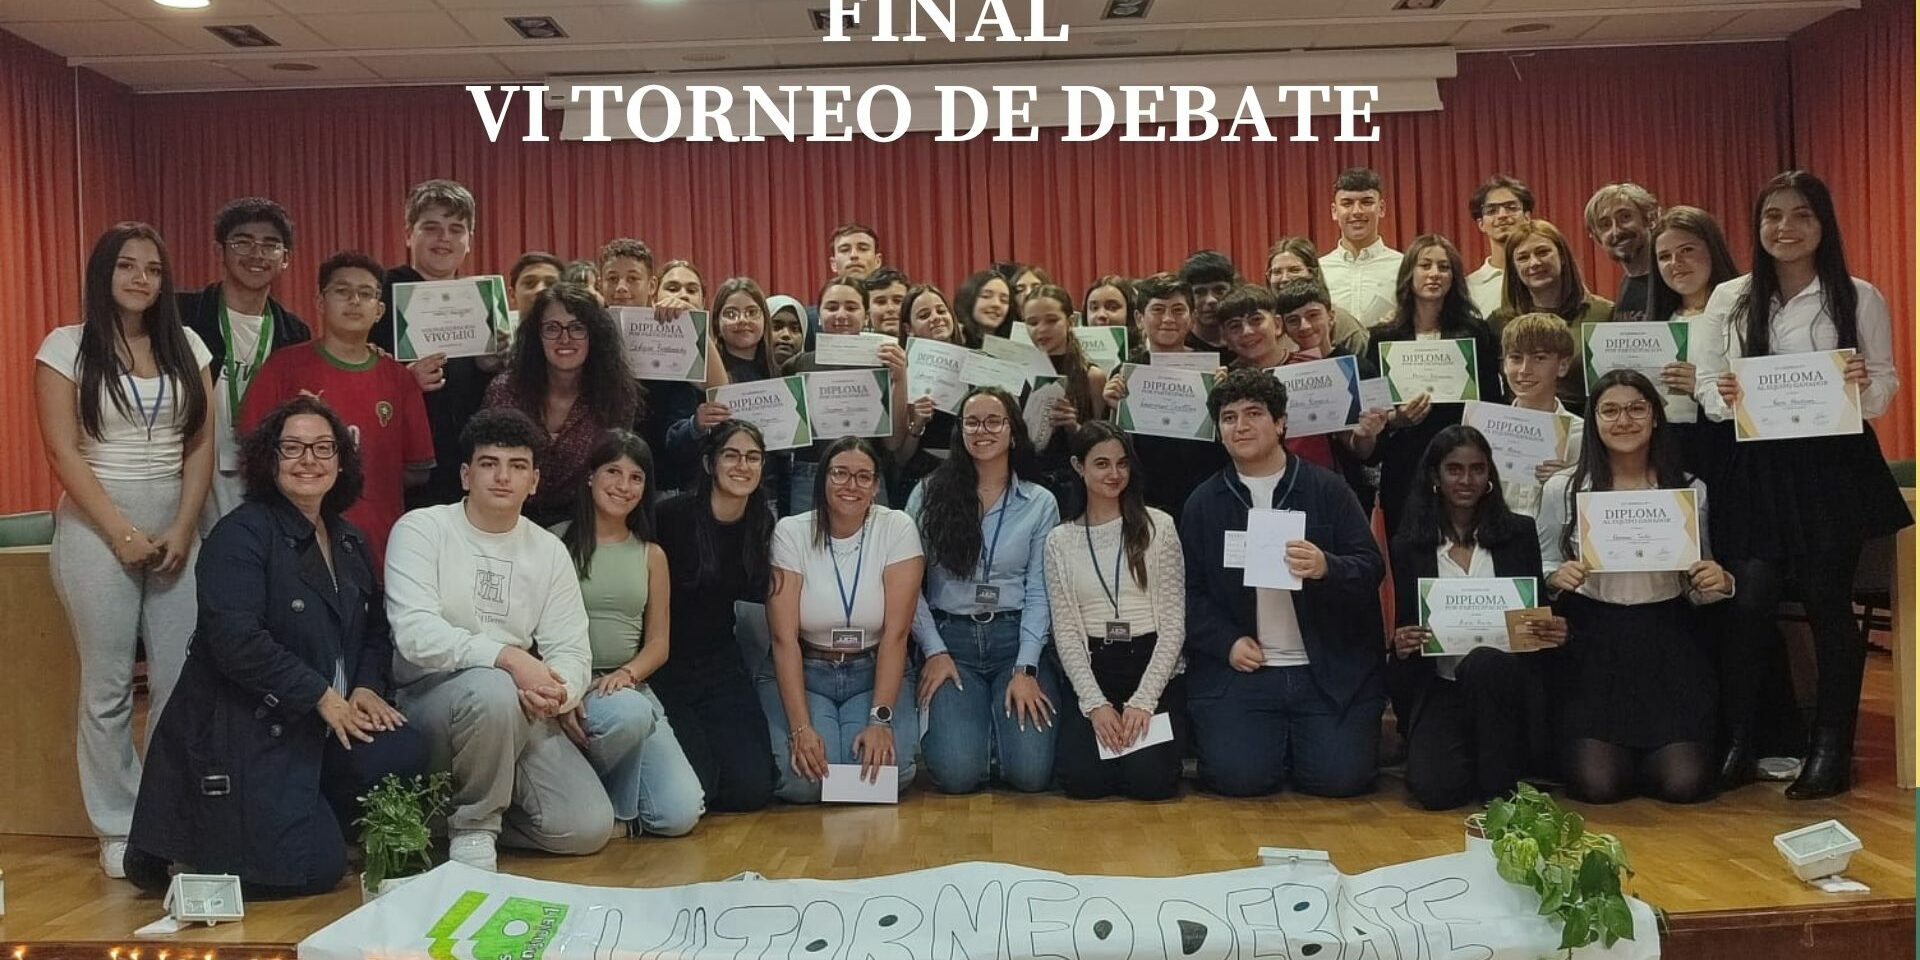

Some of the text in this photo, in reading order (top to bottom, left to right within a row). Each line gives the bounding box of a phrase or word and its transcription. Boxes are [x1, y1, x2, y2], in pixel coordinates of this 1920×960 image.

[630, 322, 683, 335] DIPLOMA
[423, 330, 475, 344] DIPLOMA
[1606, 338, 1661, 349] DIPLOMA
[918, 352, 960, 370] DIPLOMA
[1402, 353, 1451, 363] DIPLOMA
[1759, 370, 1824, 385] DIPLOMA
[819, 384, 869, 396] DIPLOMA
[1143, 379, 1194, 394] DIPLOMA
[729, 394, 781, 410] DIPLOMA
[1487, 418, 1542, 438] DIPLOMA
[1605, 507, 1667, 520] DIPLOMA
[1445, 594, 1506, 606] DIPLOMA
[714, 880, 1134, 960] TORNEO
[1157, 877, 1494, 960] DEBATE
